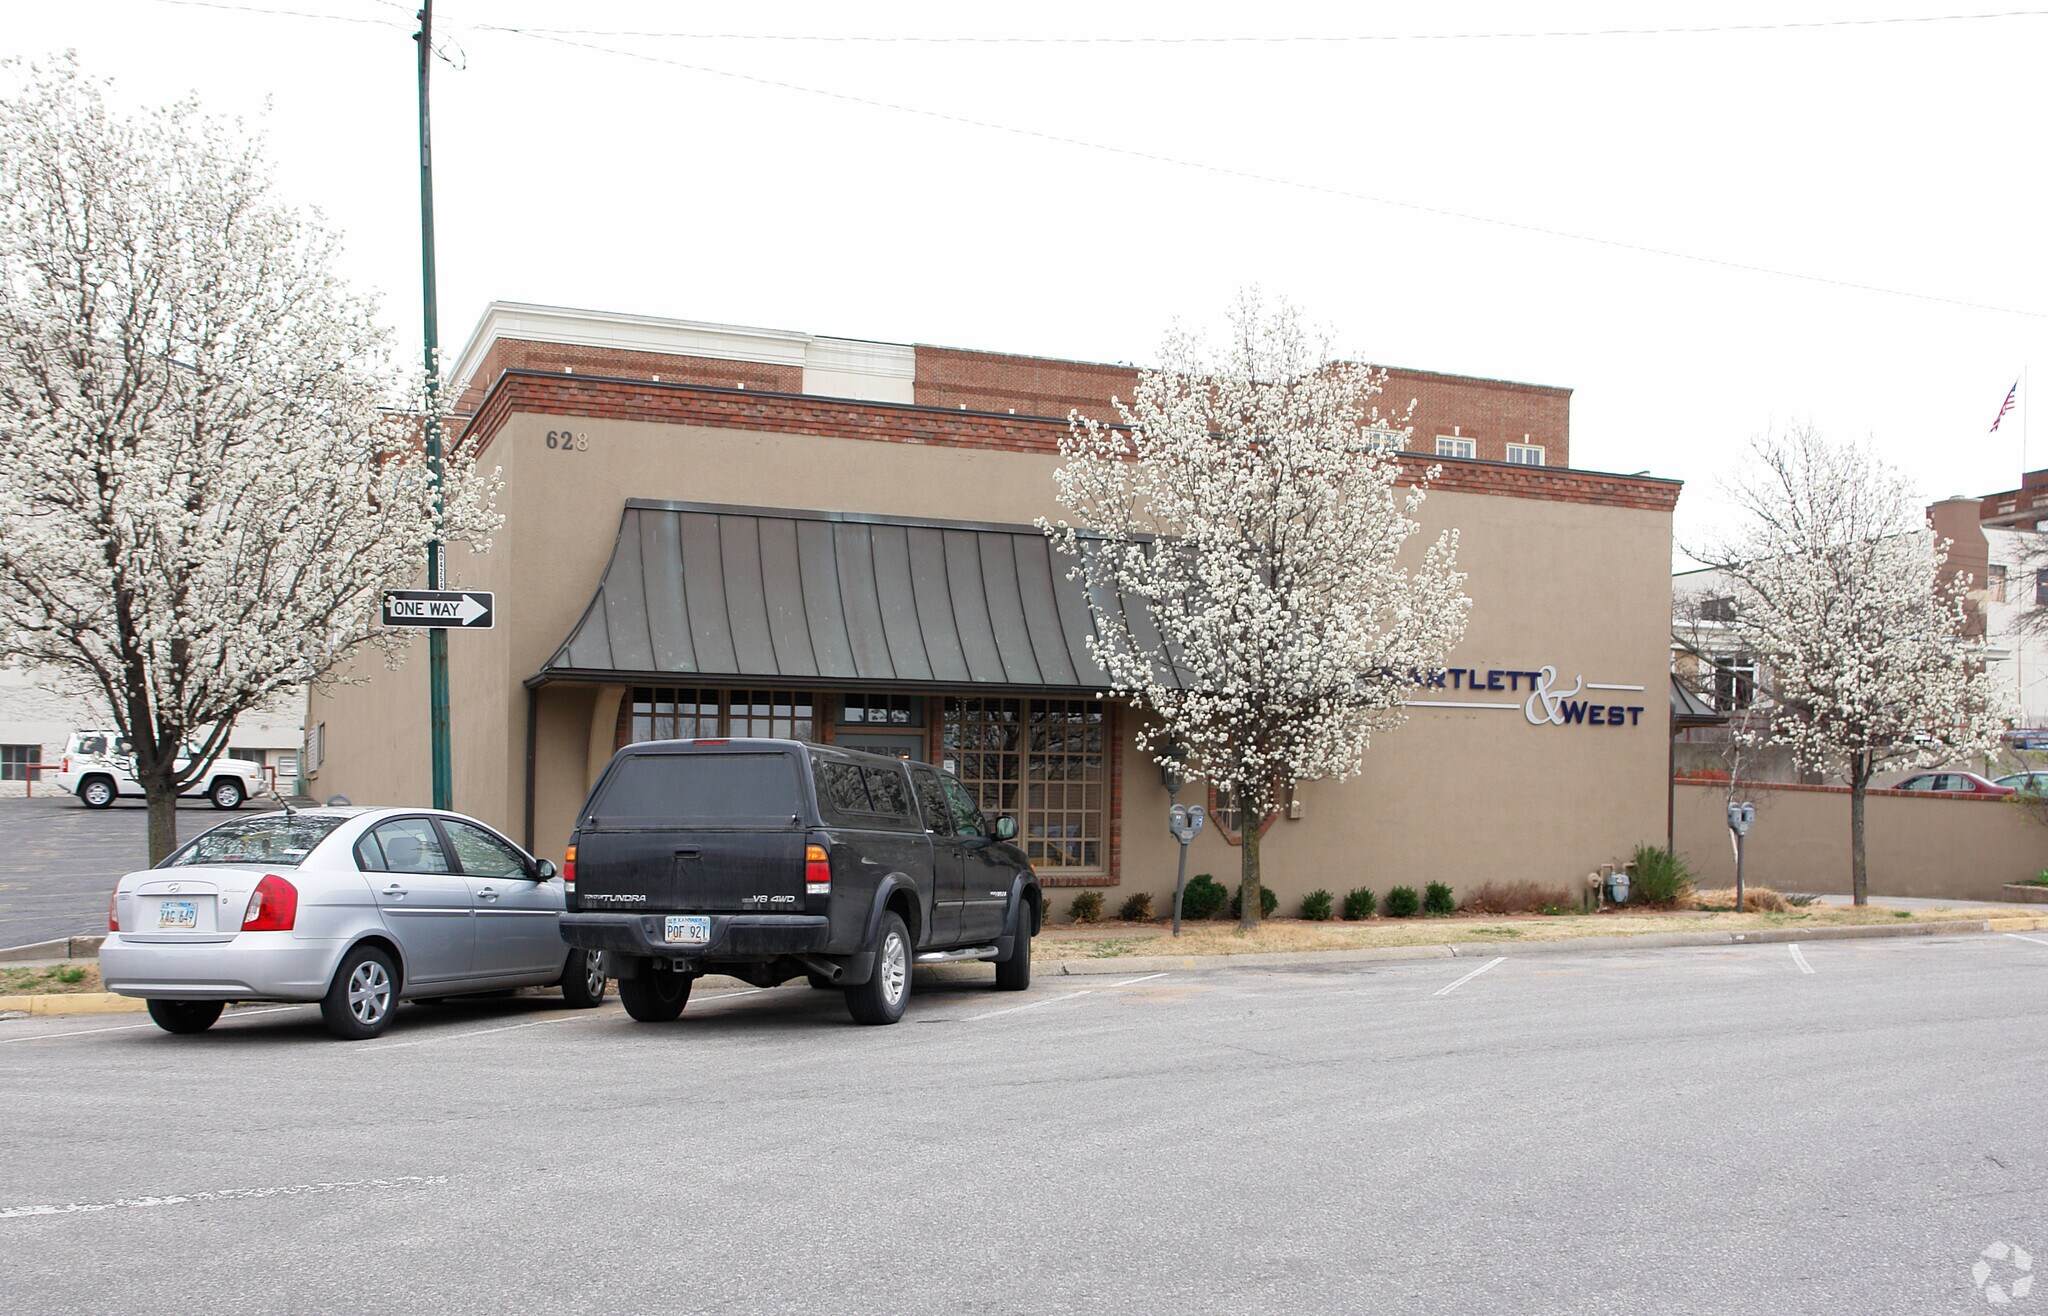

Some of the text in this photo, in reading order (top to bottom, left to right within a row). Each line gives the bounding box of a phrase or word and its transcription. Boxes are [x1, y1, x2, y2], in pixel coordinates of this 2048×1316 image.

[546, 430, 589, 452] 628
[394, 602, 460, 616] ONE WAY
[1525, 665, 1581, 725] &
[1561, 701, 1644, 726] WEST
[603, 894, 646, 902] TUNDRA
[753, 895, 768, 903] V8
[690, 926, 706, 938] 921
